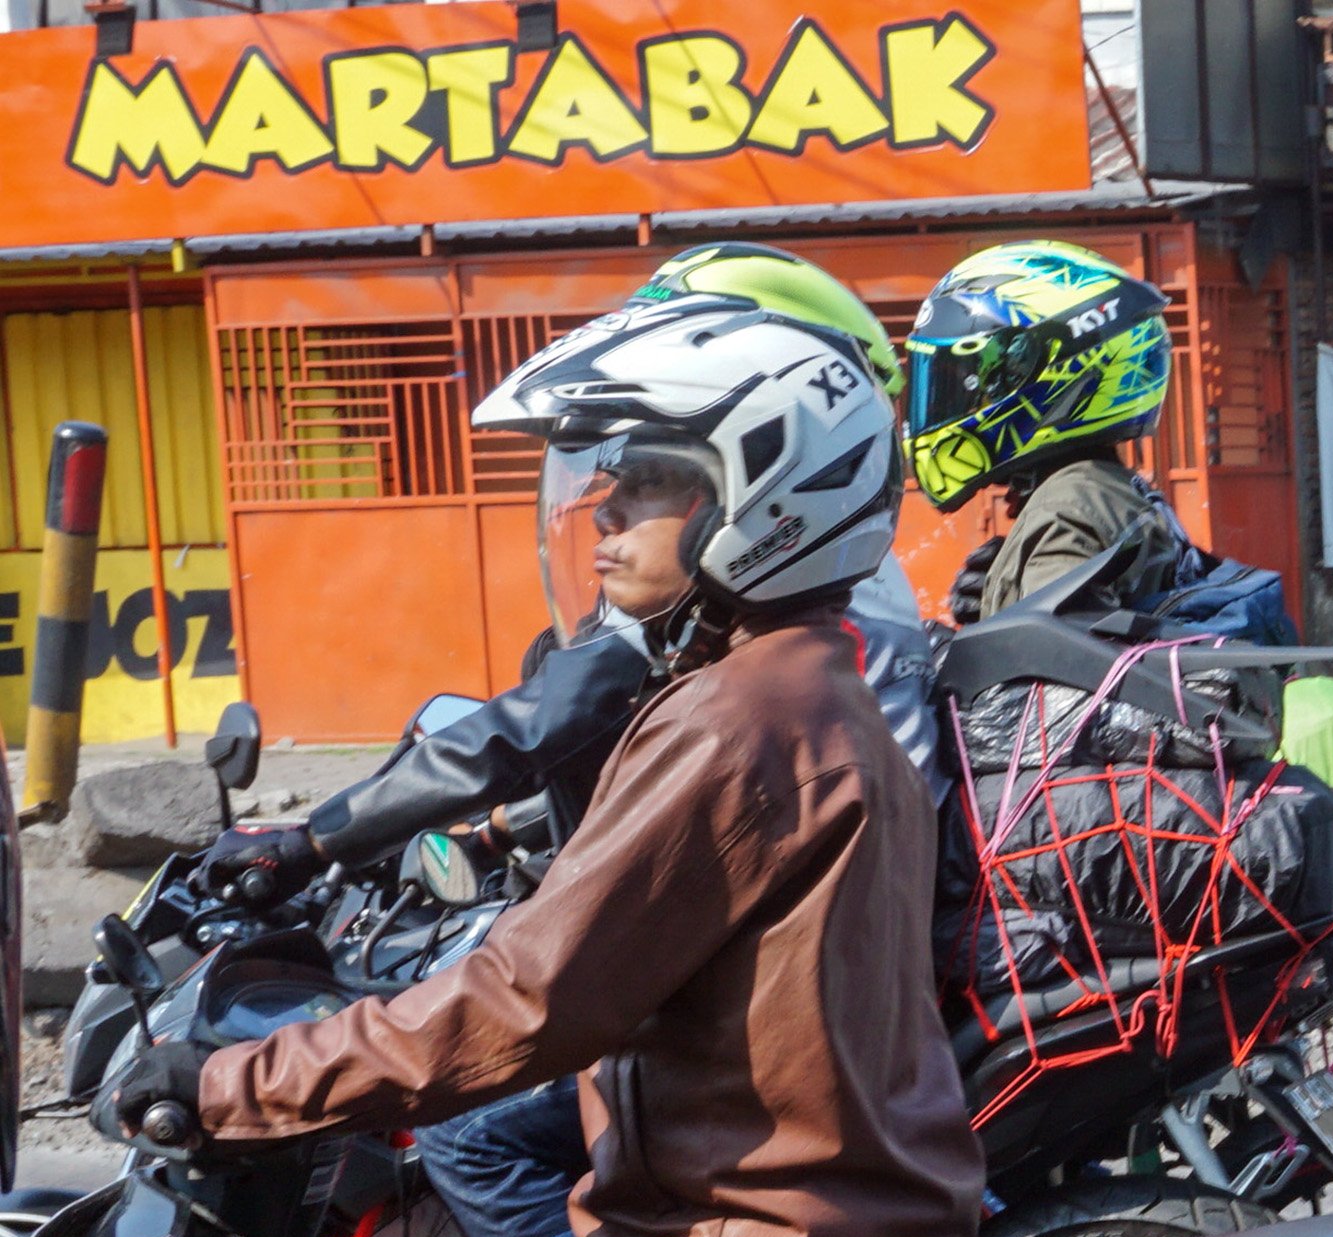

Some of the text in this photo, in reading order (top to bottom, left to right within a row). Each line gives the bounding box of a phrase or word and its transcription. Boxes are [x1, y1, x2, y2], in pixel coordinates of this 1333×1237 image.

[66, 11, 997, 187] MARTABAK
[1066, 297, 1121, 339] KYT
[807, 360, 859, 411] X3
[726, 516, 808, 575] PREMIER
